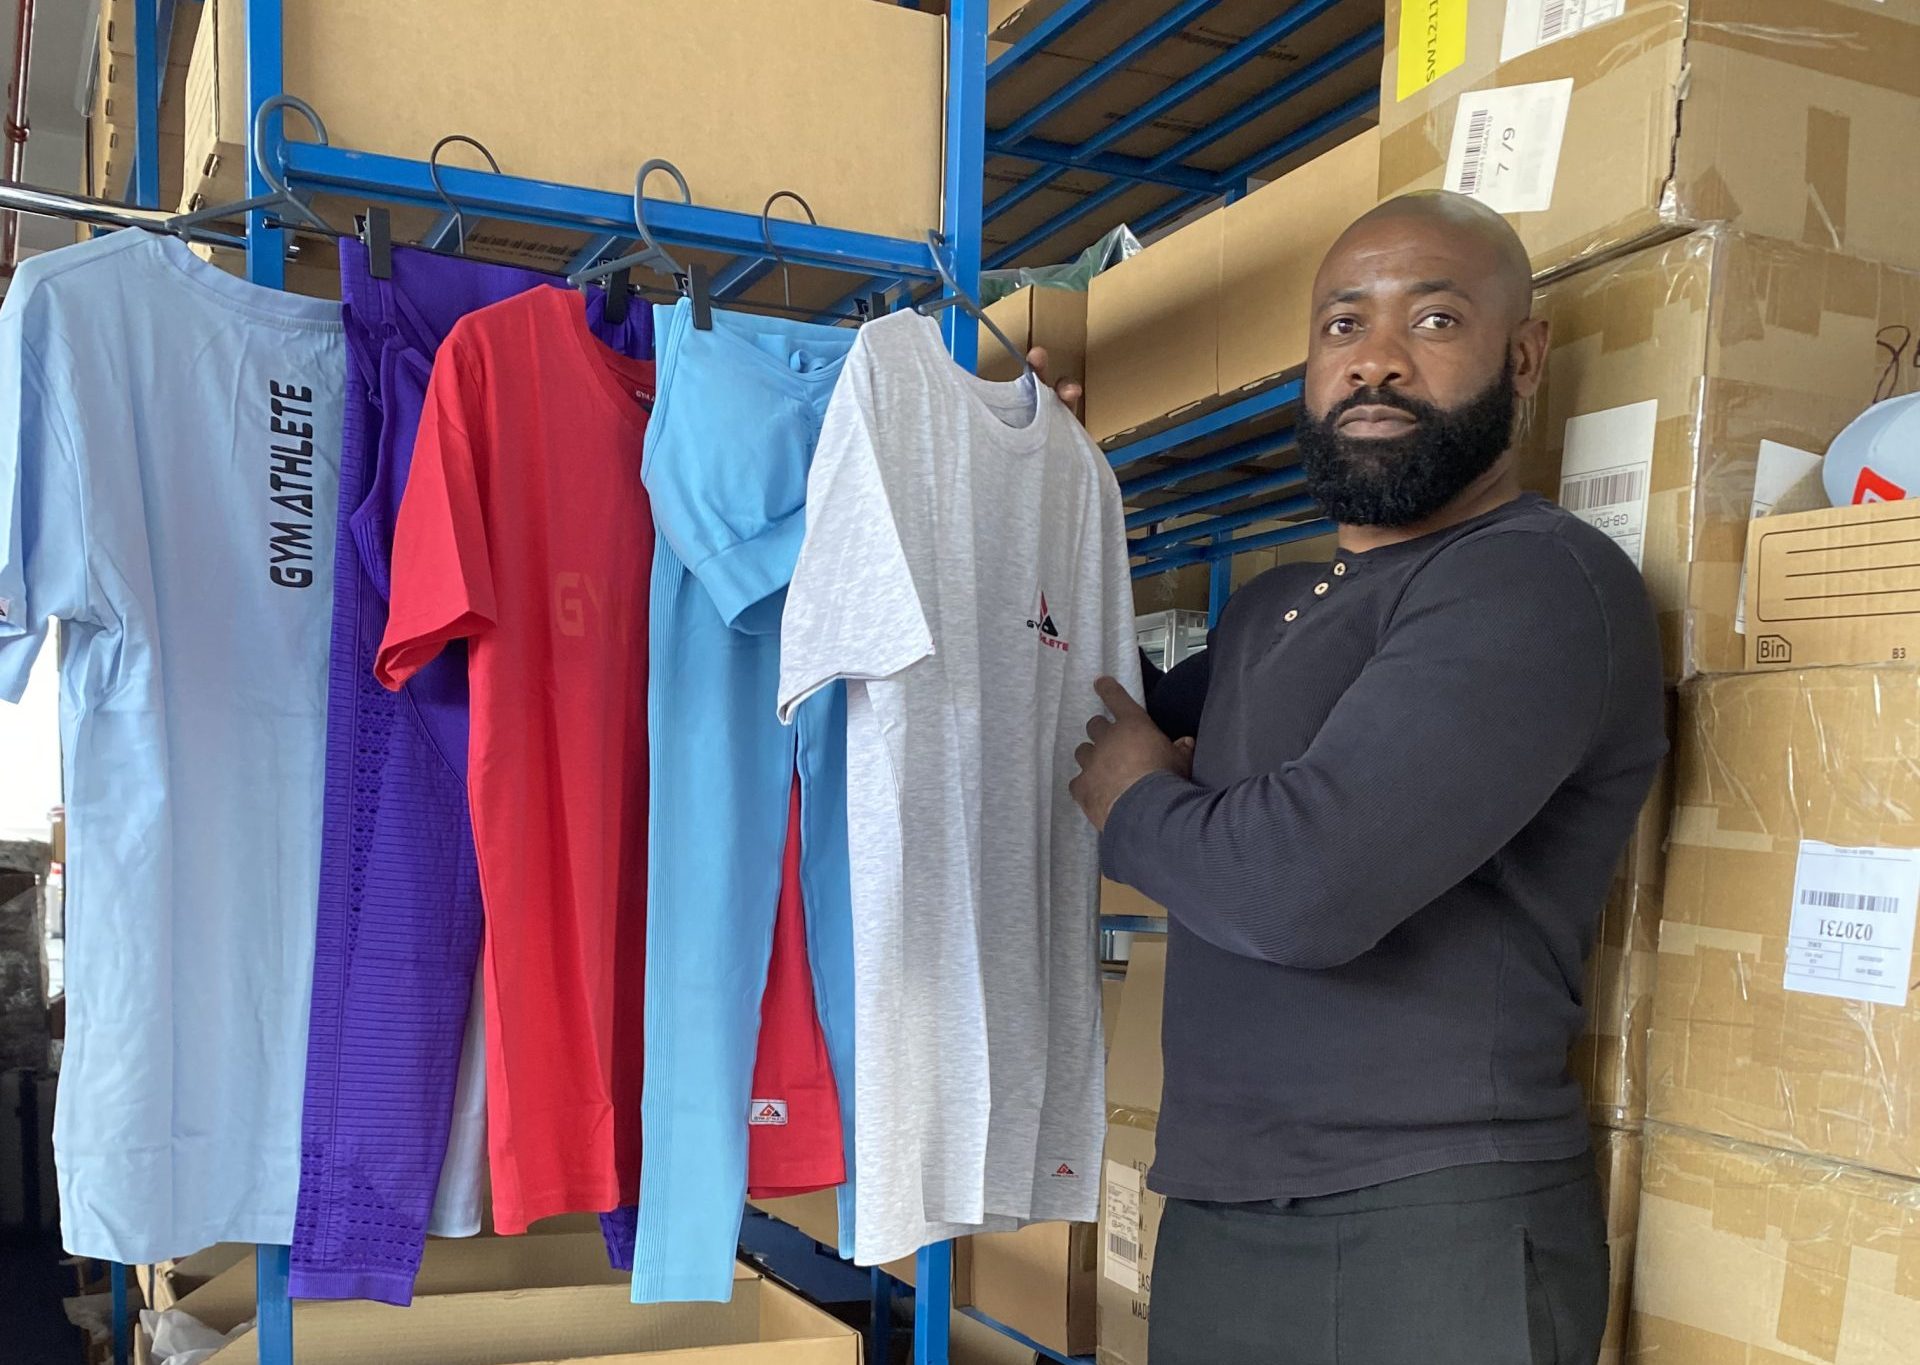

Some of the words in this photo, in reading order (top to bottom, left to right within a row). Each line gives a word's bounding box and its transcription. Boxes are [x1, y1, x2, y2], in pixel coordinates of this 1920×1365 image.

[269, 379, 313, 518] ATHLETE
[269, 522, 313, 588] GYM
[1760, 640, 1786, 658] Bin
[1892, 647, 1906, 659] B3
[1819, 919, 1873, 941] 020731
